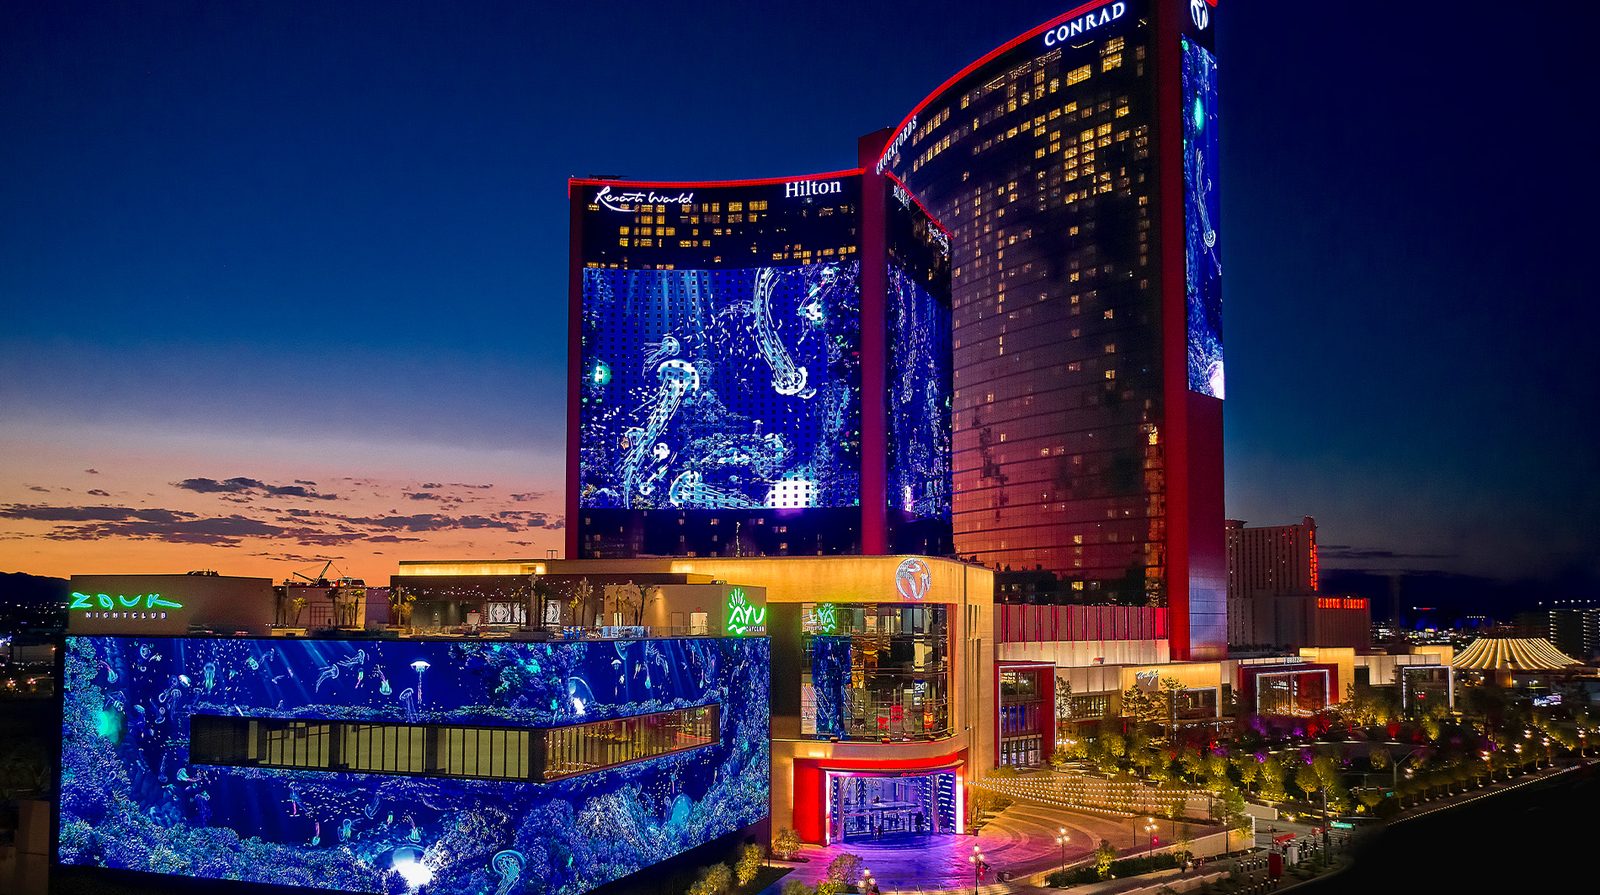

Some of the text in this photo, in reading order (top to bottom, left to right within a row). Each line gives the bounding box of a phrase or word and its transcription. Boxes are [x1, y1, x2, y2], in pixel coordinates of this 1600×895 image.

[1044, 2, 1126, 47] CONRAD
[876, 115, 917, 175] CROCKFORDS
[648, 192, 694, 203] World
[785, 180, 842, 198] Hilton
[70, 592, 183, 610] ZOUK
[728, 605, 765, 625] AYU
